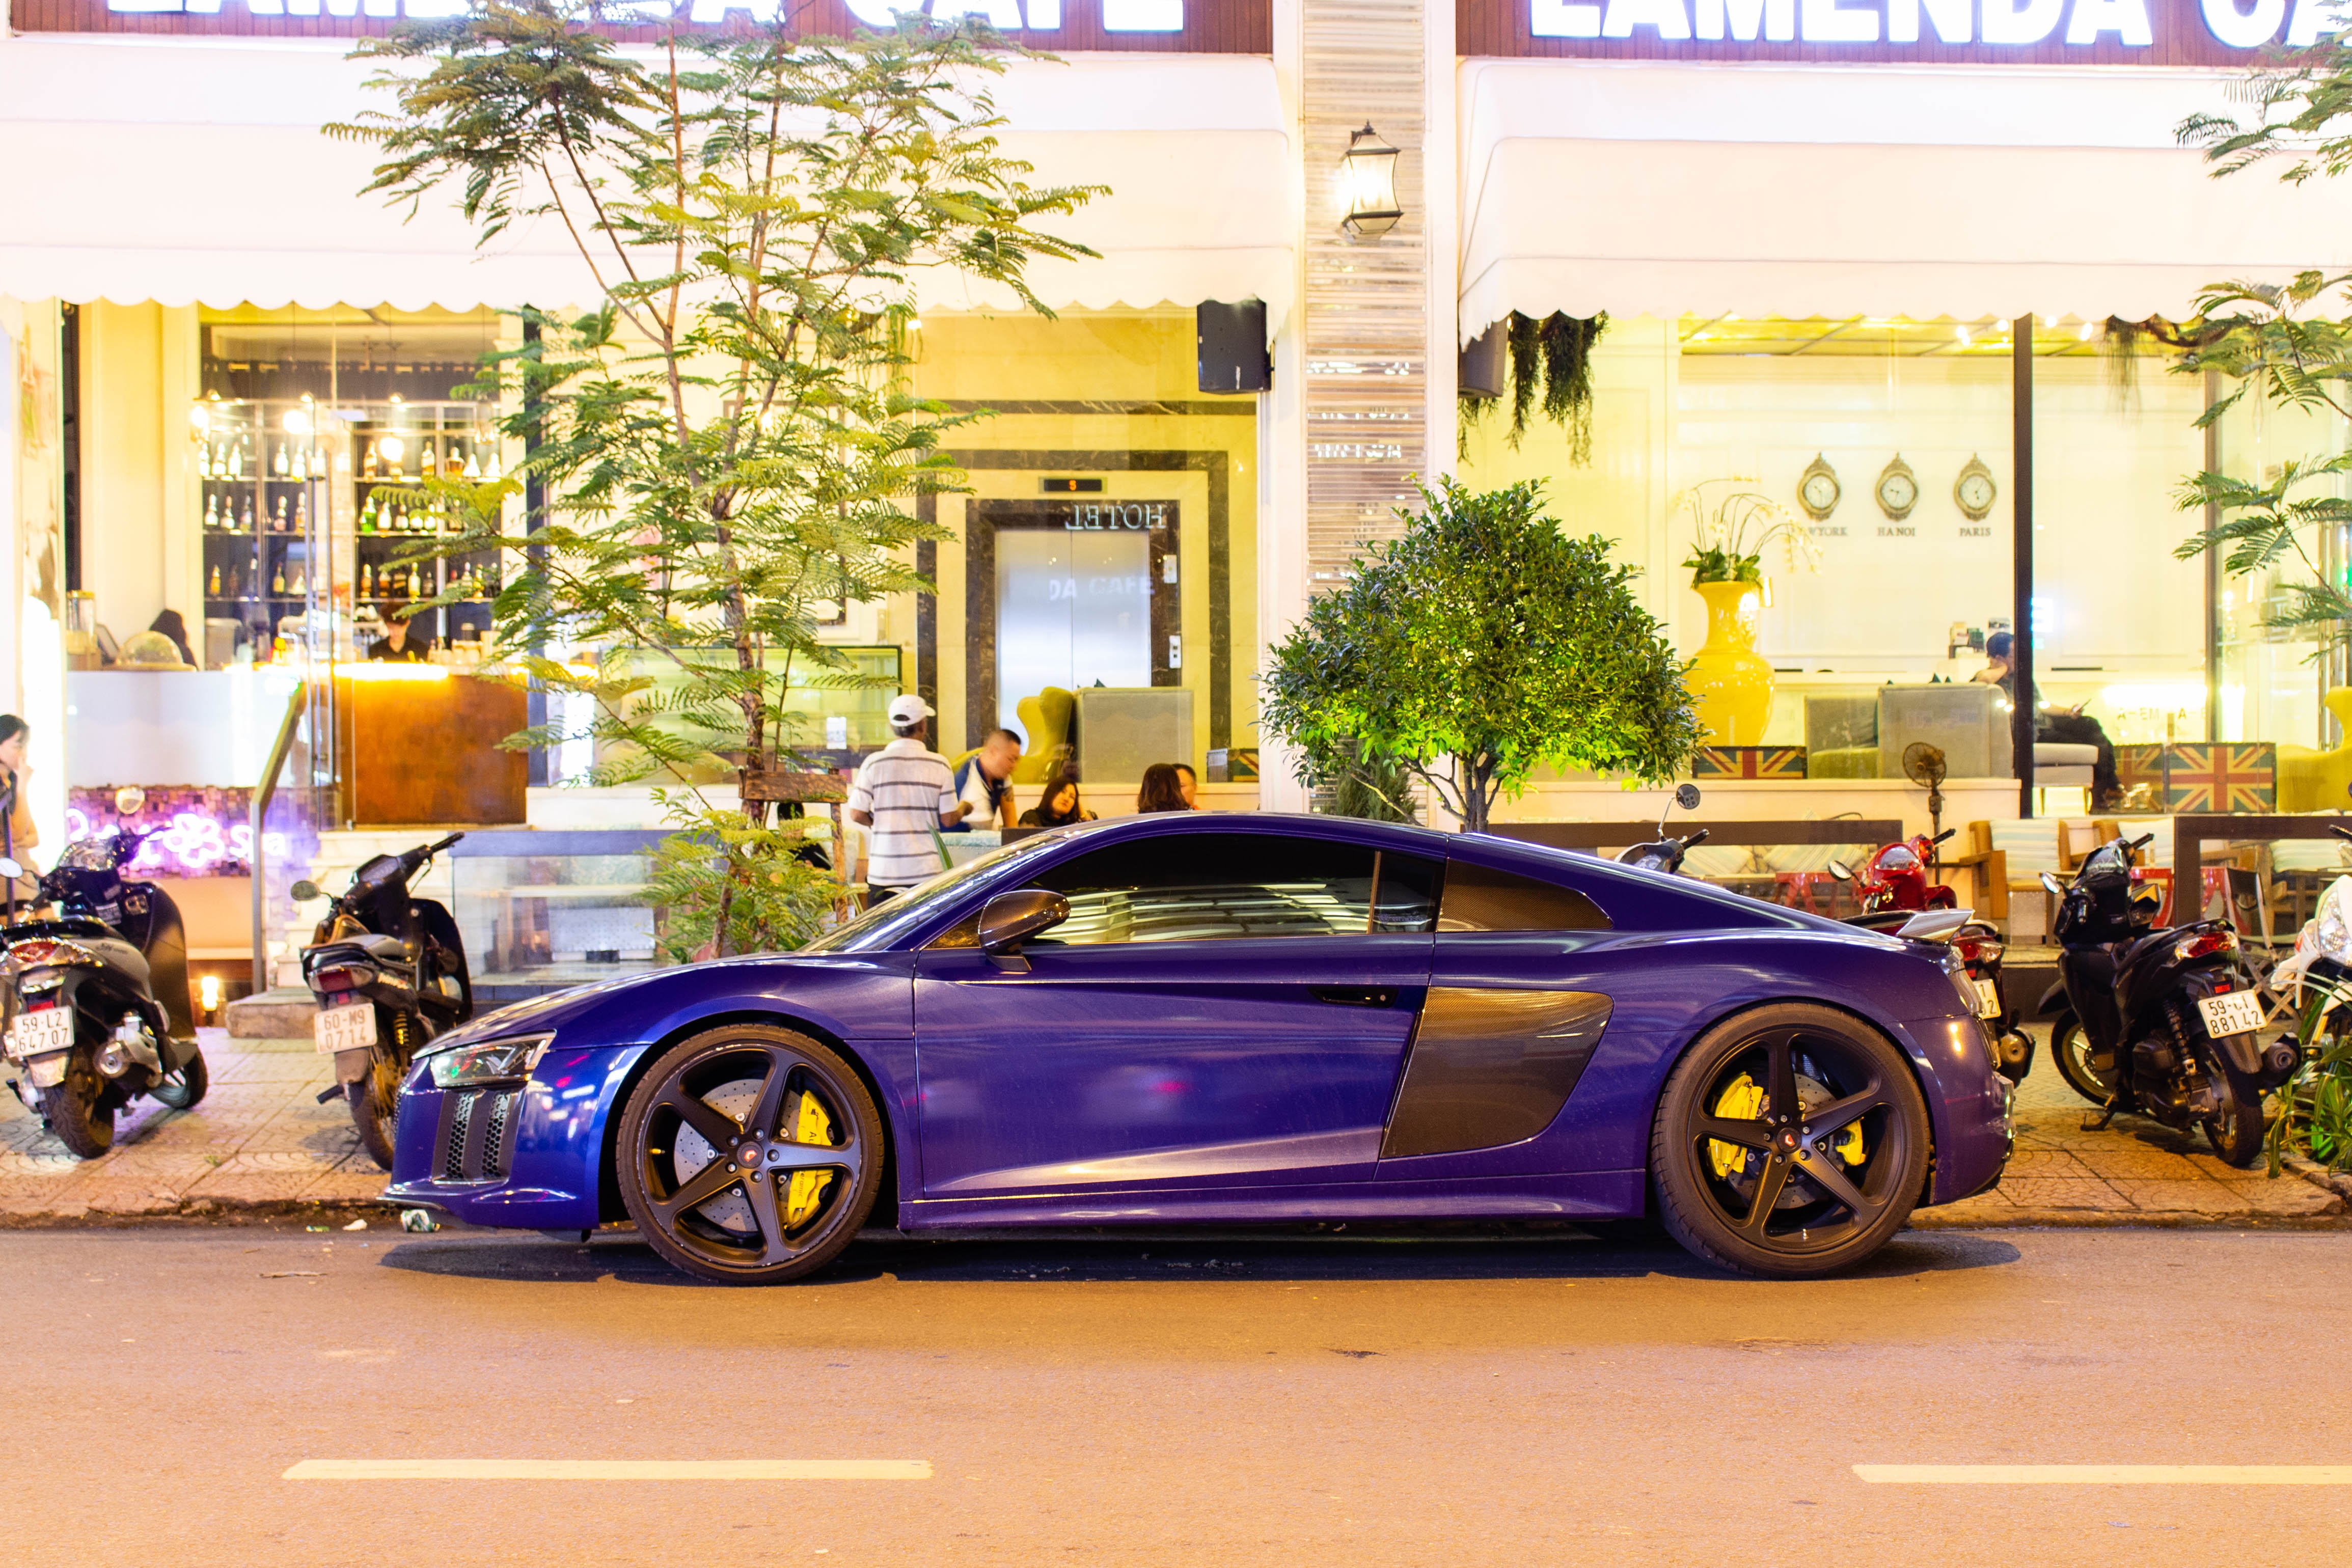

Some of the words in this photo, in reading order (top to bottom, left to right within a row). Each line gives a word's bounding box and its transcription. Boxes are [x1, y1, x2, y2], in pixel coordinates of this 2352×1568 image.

[1960, 527, 1991, 536] PARIS
[324, 1009, 366, 1031] 60-M9
[2210, 1010, 2261, 1034] 881.42
